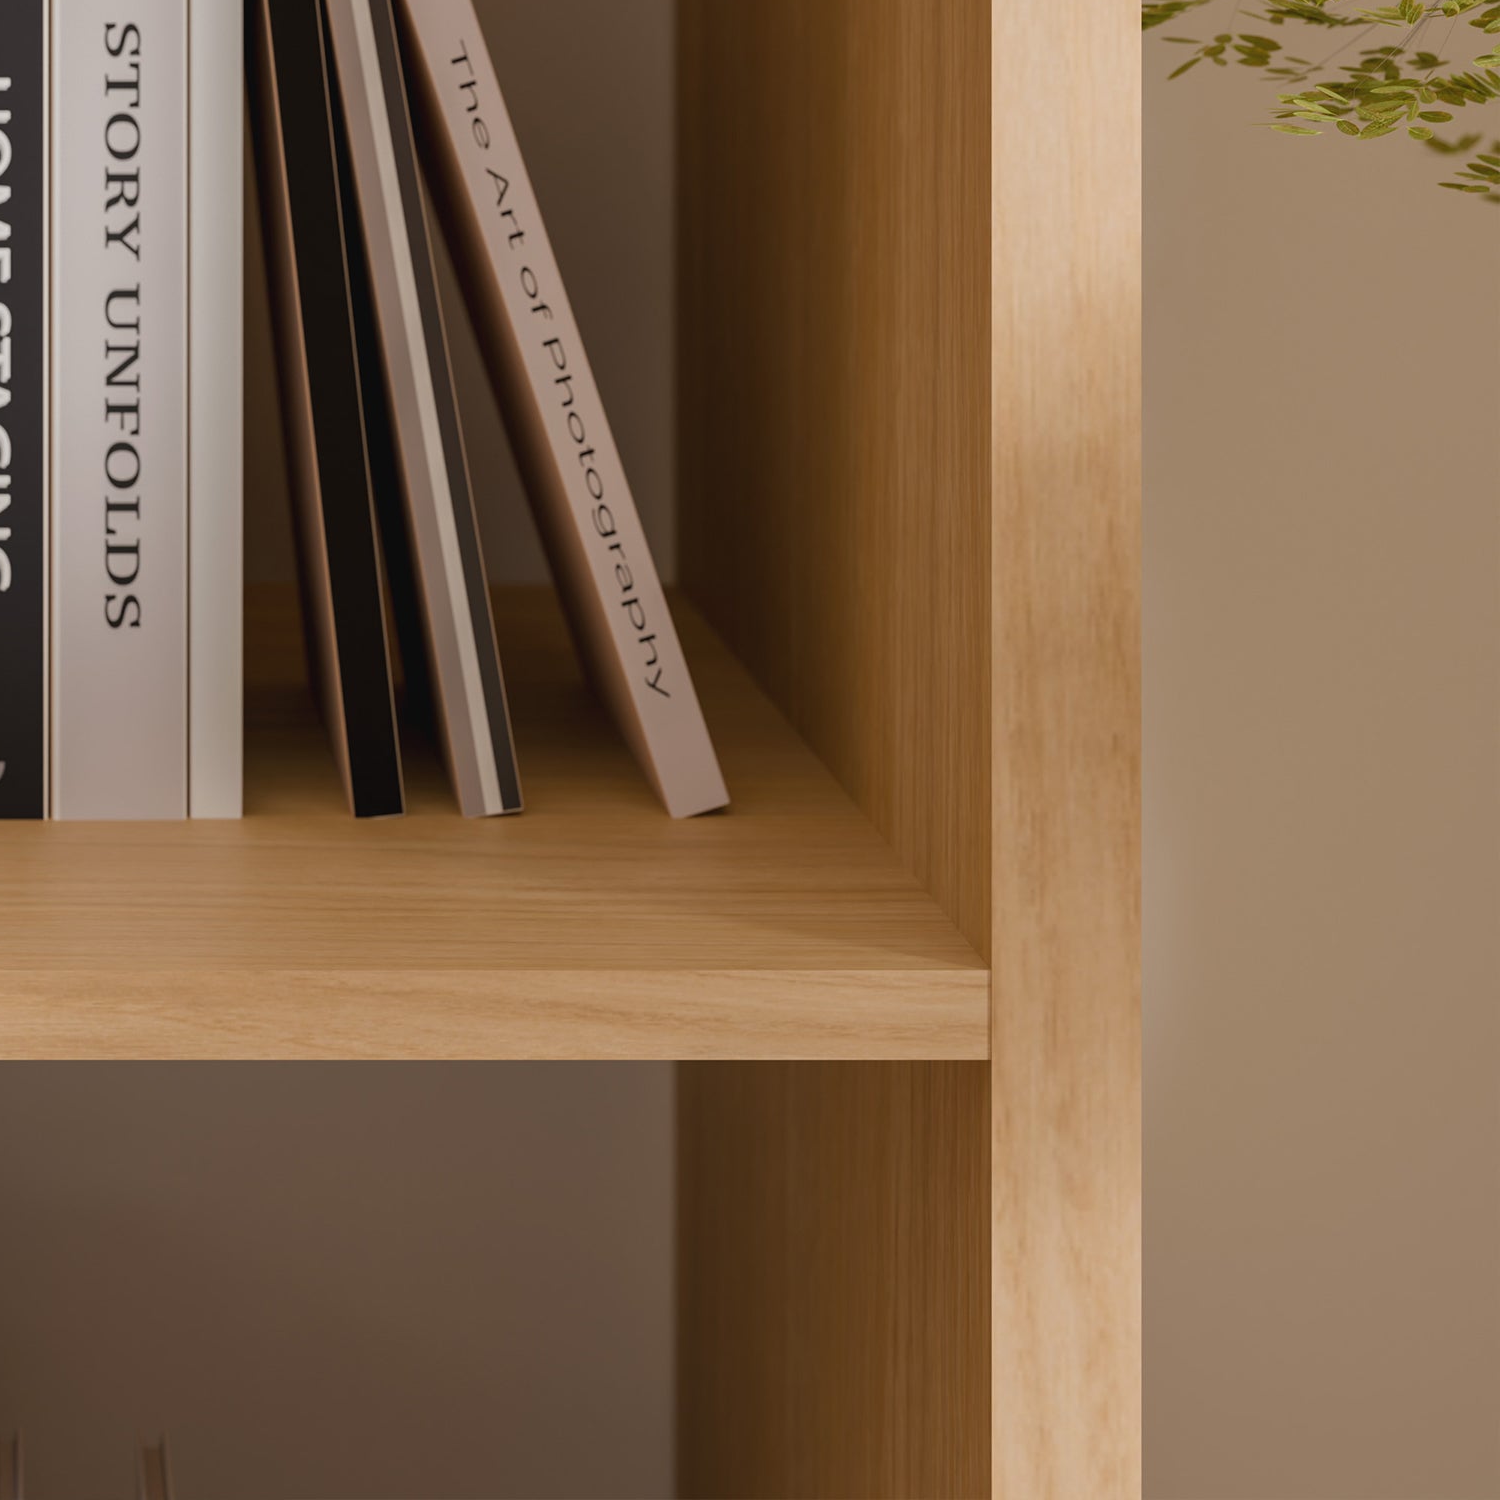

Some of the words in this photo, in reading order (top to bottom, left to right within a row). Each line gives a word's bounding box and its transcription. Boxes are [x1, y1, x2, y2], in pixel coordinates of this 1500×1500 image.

[104, 21, 142, 262] STORY
[104, 282, 142, 630] UNFOLDS
[450, 38, 493, 152] The
[485, 166, 527, 251] Art
[518, 265, 556, 322] of
[541, 335, 672, 700] Photography
